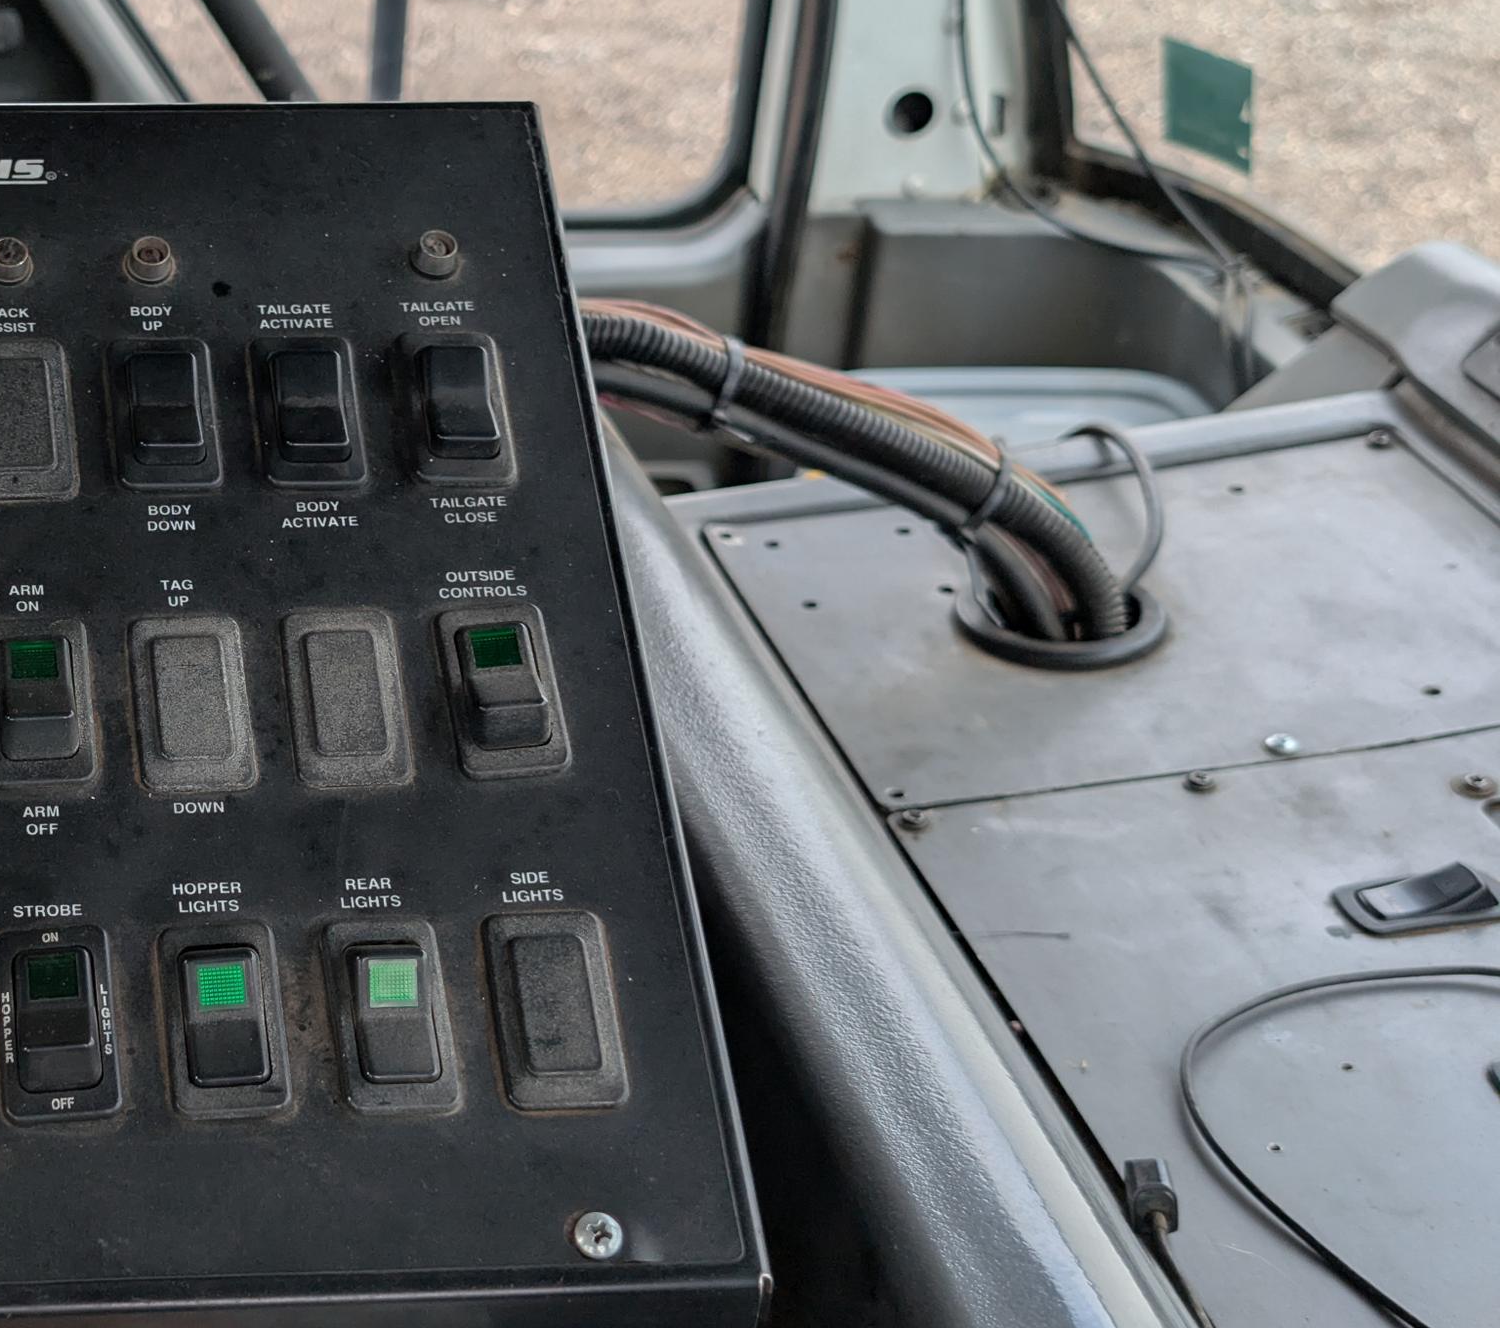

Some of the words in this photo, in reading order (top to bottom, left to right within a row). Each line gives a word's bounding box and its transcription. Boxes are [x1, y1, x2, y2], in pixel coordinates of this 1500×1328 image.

[129, 305, 172, 317] BODY
[257, 303, 332, 315] TAILGATE
[399, 300, 475, 313] TAILGATE
[142, 320, 163, 331] UP
[259, 317, 334, 330] ACTIVATE
[418, 315, 461, 327] OPEN
[295, 500, 339, 513] BODY
[429, 495, 507, 509] TAILGATE
[147, 504, 191, 516] BODY
[281, 515, 359, 529] ACTIVATE
[444, 511, 498, 524] CLOSE
[147, 520, 196, 532] DOWN
[445, 569, 516, 583] OUTSIDE
[8, 584, 45, 596] ARM
[159, 579, 194, 591] TAG
[438, 585, 528, 599] CONTROLS
[15, 600, 39, 612] ON
[167, 595, 189, 607] UP
[22, 805, 60, 818] ARM
[173, 801, 225, 814] DOWN
[25, 822, 59, 836] OFF
[345, 877, 392, 891] REAR
[510, 871, 550, 885] SIDE
[172, 881, 242, 896] HOPPER
[340, 894, 402, 909] LIGHTS
[502, 888, 564, 903] LIGHTS
[12, 903, 83, 918] STROBE
[178, 899, 240, 913] LIGHTS
[42, 932, 58, 943] ON
[100, 984, 113, 1055] LIGHTS
[1, 992, 14, 1063] HOPPER
[51, 1097, 75, 1110] OFF
